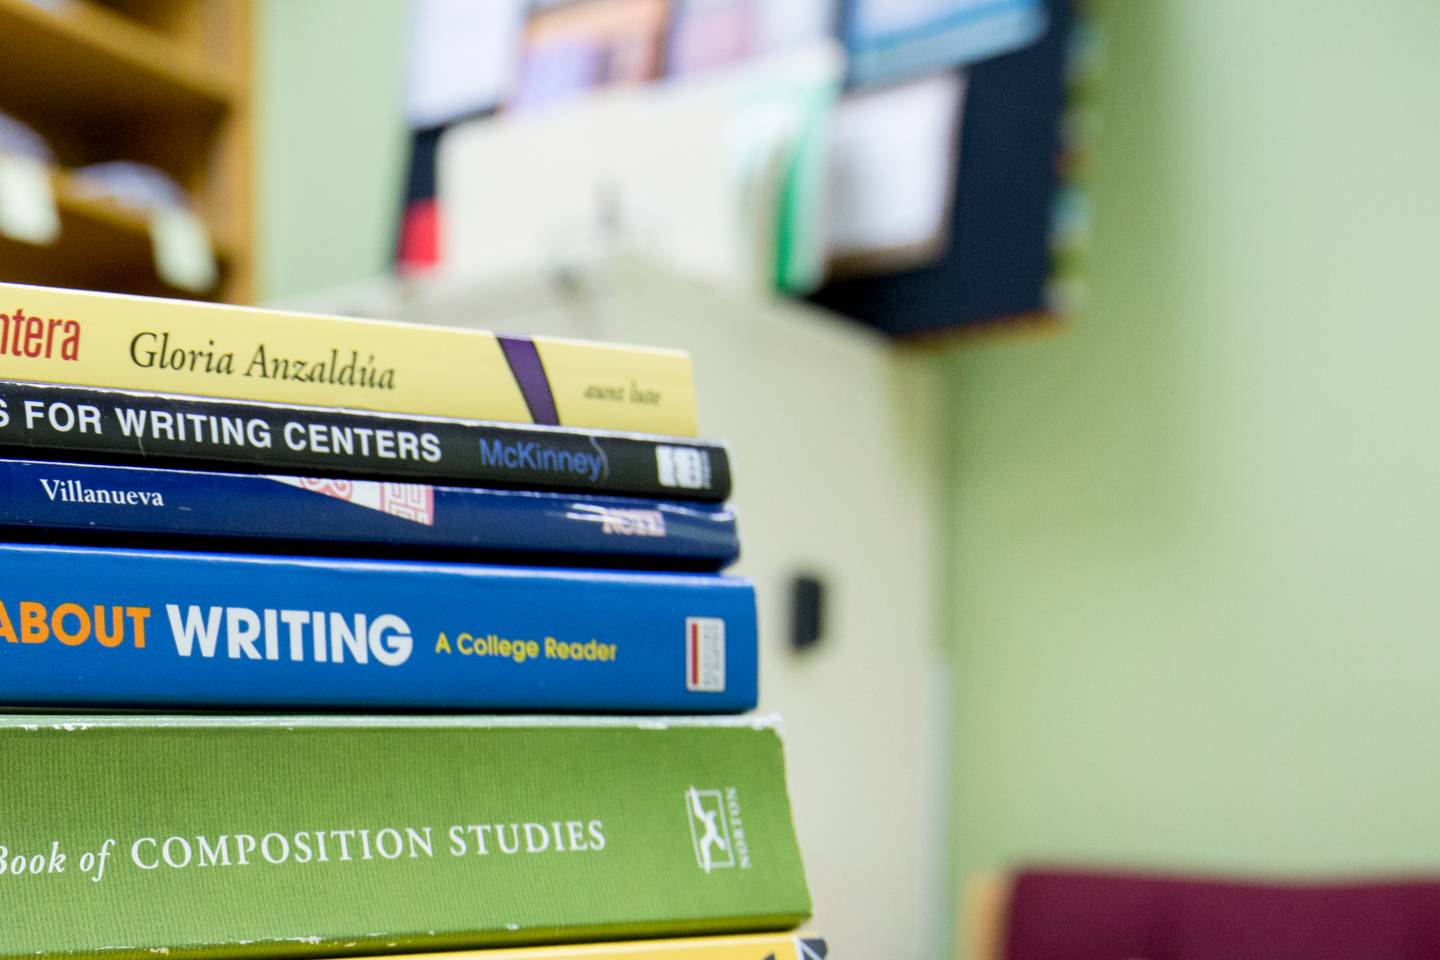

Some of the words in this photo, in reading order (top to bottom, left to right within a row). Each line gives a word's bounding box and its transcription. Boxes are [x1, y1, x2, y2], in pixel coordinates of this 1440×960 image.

[129, 332, 236, 375] Gloria
[243, 343, 396, 391] Anzaldúa
[25, 401, 102, 434] FOR
[116, 407, 271, 448] WRITING
[284, 422, 441, 462] CENTERS
[479, 438, 602, 481] McKinney
[40, 479, 163, 506] Villanueva
[166, 603, 413, 667] WRITING
[435, 633, 451, 654] A
[457, 633, 541, 662] College
[545, 637, 617, 661] Reader
[79, 839, 116, 881] of
[131, 827, 433, 869] COMPOSITION
[449, 820, 606, 858] STUDIES
[726, 786, 753, 869] NORTON
